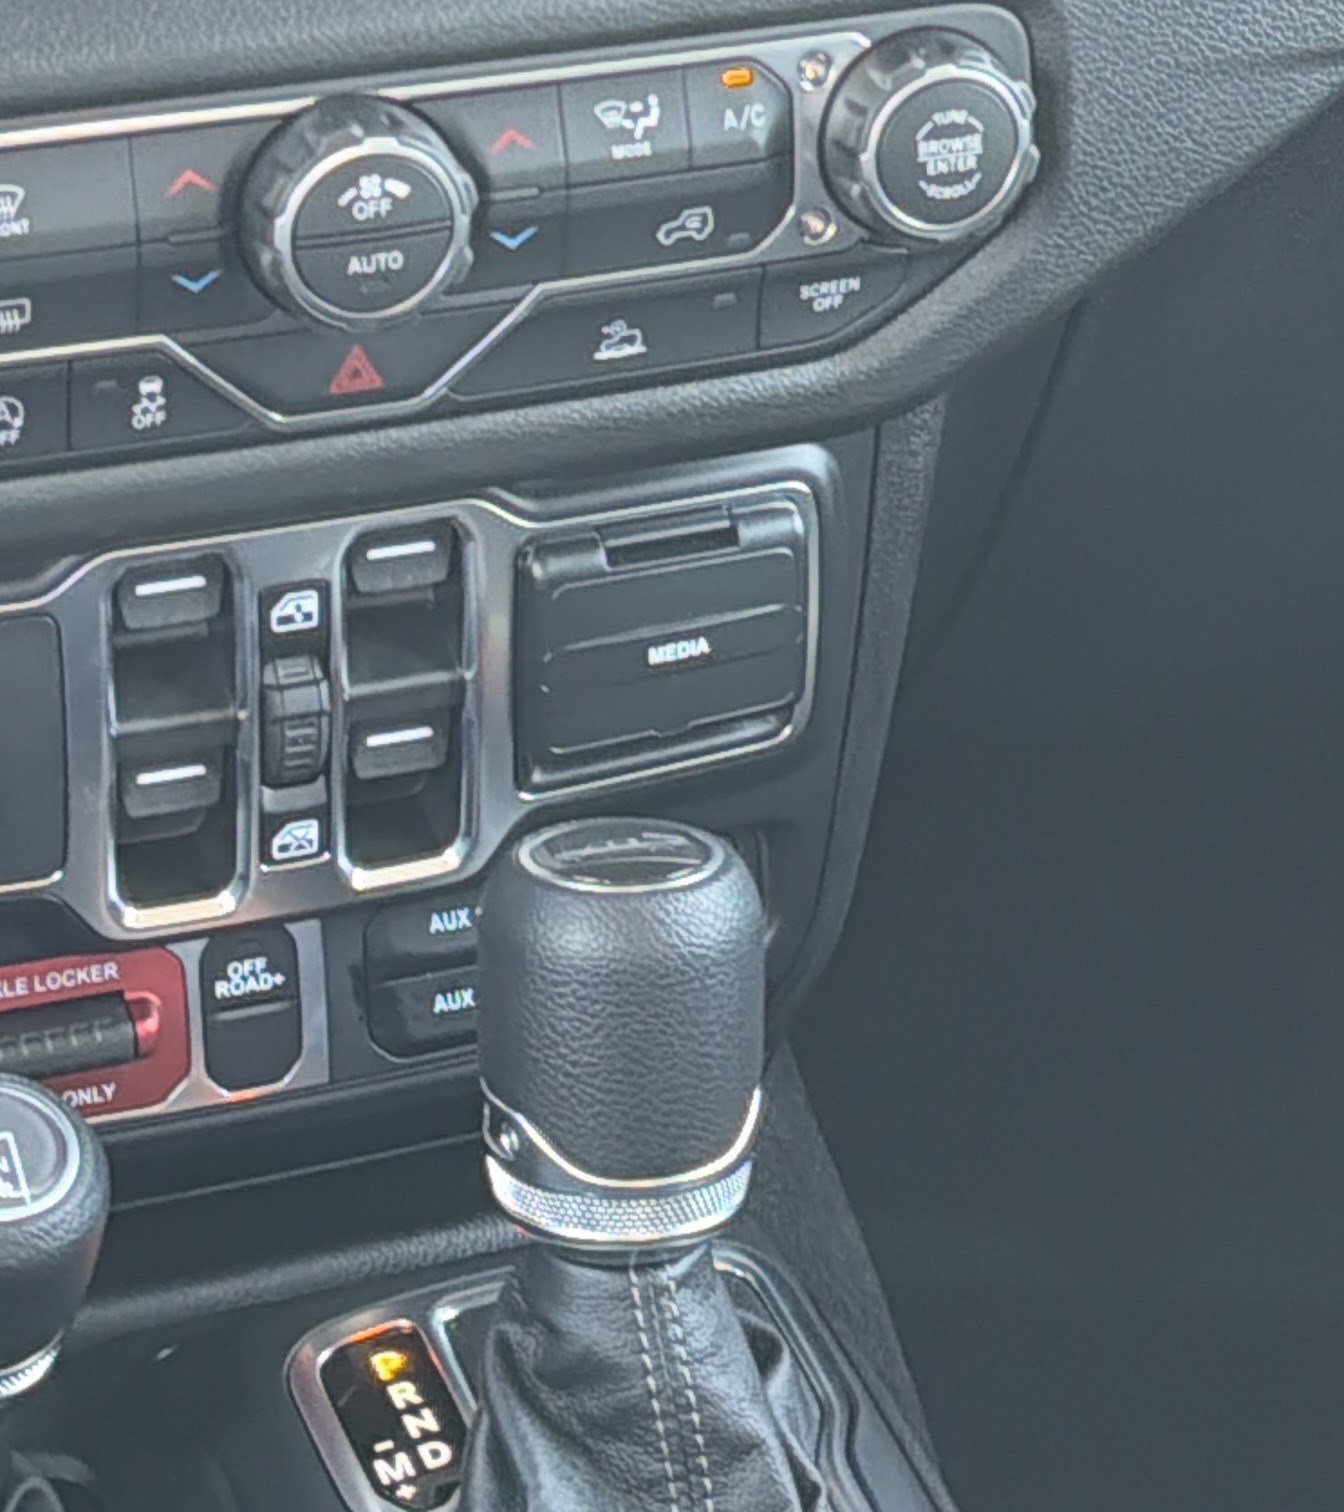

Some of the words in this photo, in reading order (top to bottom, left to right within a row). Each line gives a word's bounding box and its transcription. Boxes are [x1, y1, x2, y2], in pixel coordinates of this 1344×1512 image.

[723, 105, 768, 133] A/C
[917, 134, 983, 161] BROWSE
[927, 155, 978, 176] ENTER
[352, 197, 393, 222] OFF
[346, 248, 405, 276] AUTO
[800, 276, 861, 300] SCREEN
[813, 294, 843, 313] OFF
[132, 407, 167, 430] OFF
[647, 636, 712, 666] MEDIA
[430, 906, 473, 935] AUX
[32, 960, 120, 993] LOCKER
[227, 957, 267, 978] OFF
[433, 987, 476, 1015] AUX
[62, 1082, 117, 1108] ONLY
[369, 1349, 407, 1382] P
[387, 1381, 423, 1410] R
[401, 1407, 441, 1439] N
[373, 1451, 417, 1486] M
[416, 1440, 453, 1470] D
